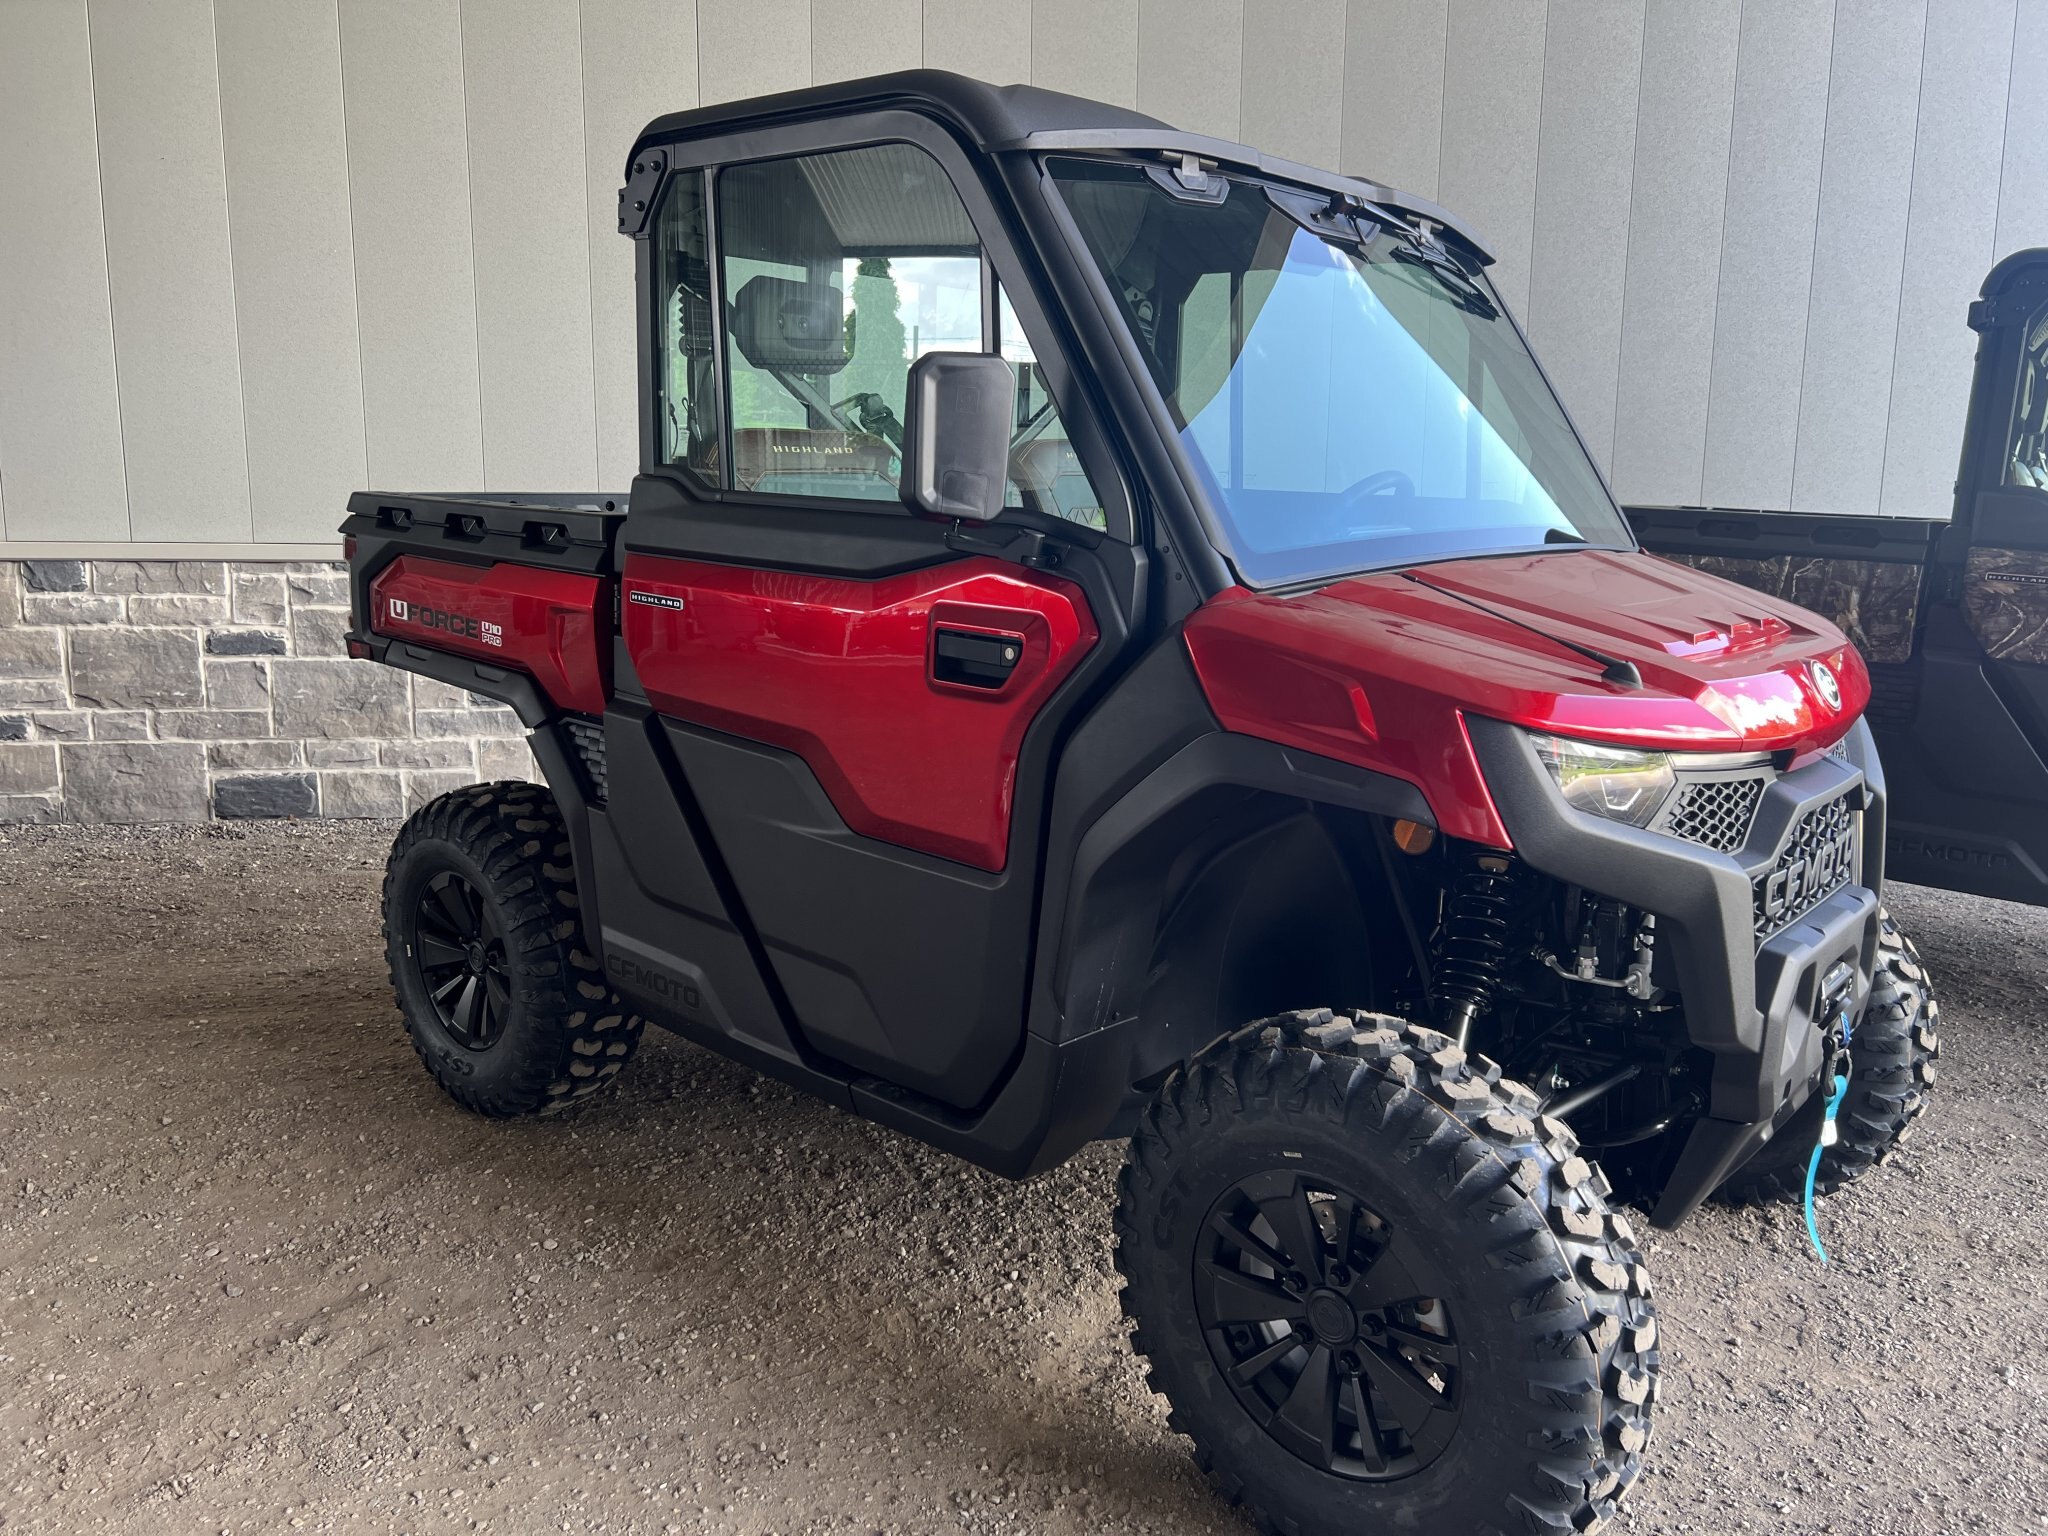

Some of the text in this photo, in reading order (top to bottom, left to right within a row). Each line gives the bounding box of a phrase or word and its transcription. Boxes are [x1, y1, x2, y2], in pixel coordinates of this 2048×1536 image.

[772, 445, 854, 455] HIGHLAND
[1988, 575, 2047, 584] HIGHLAN
[631, 593, 681, 608] HIGHLAND
[481, 620, 503, 636] U10
[481, 633, 503, 648] PRO
[607, 953, 700, 1009] CFMOTO
